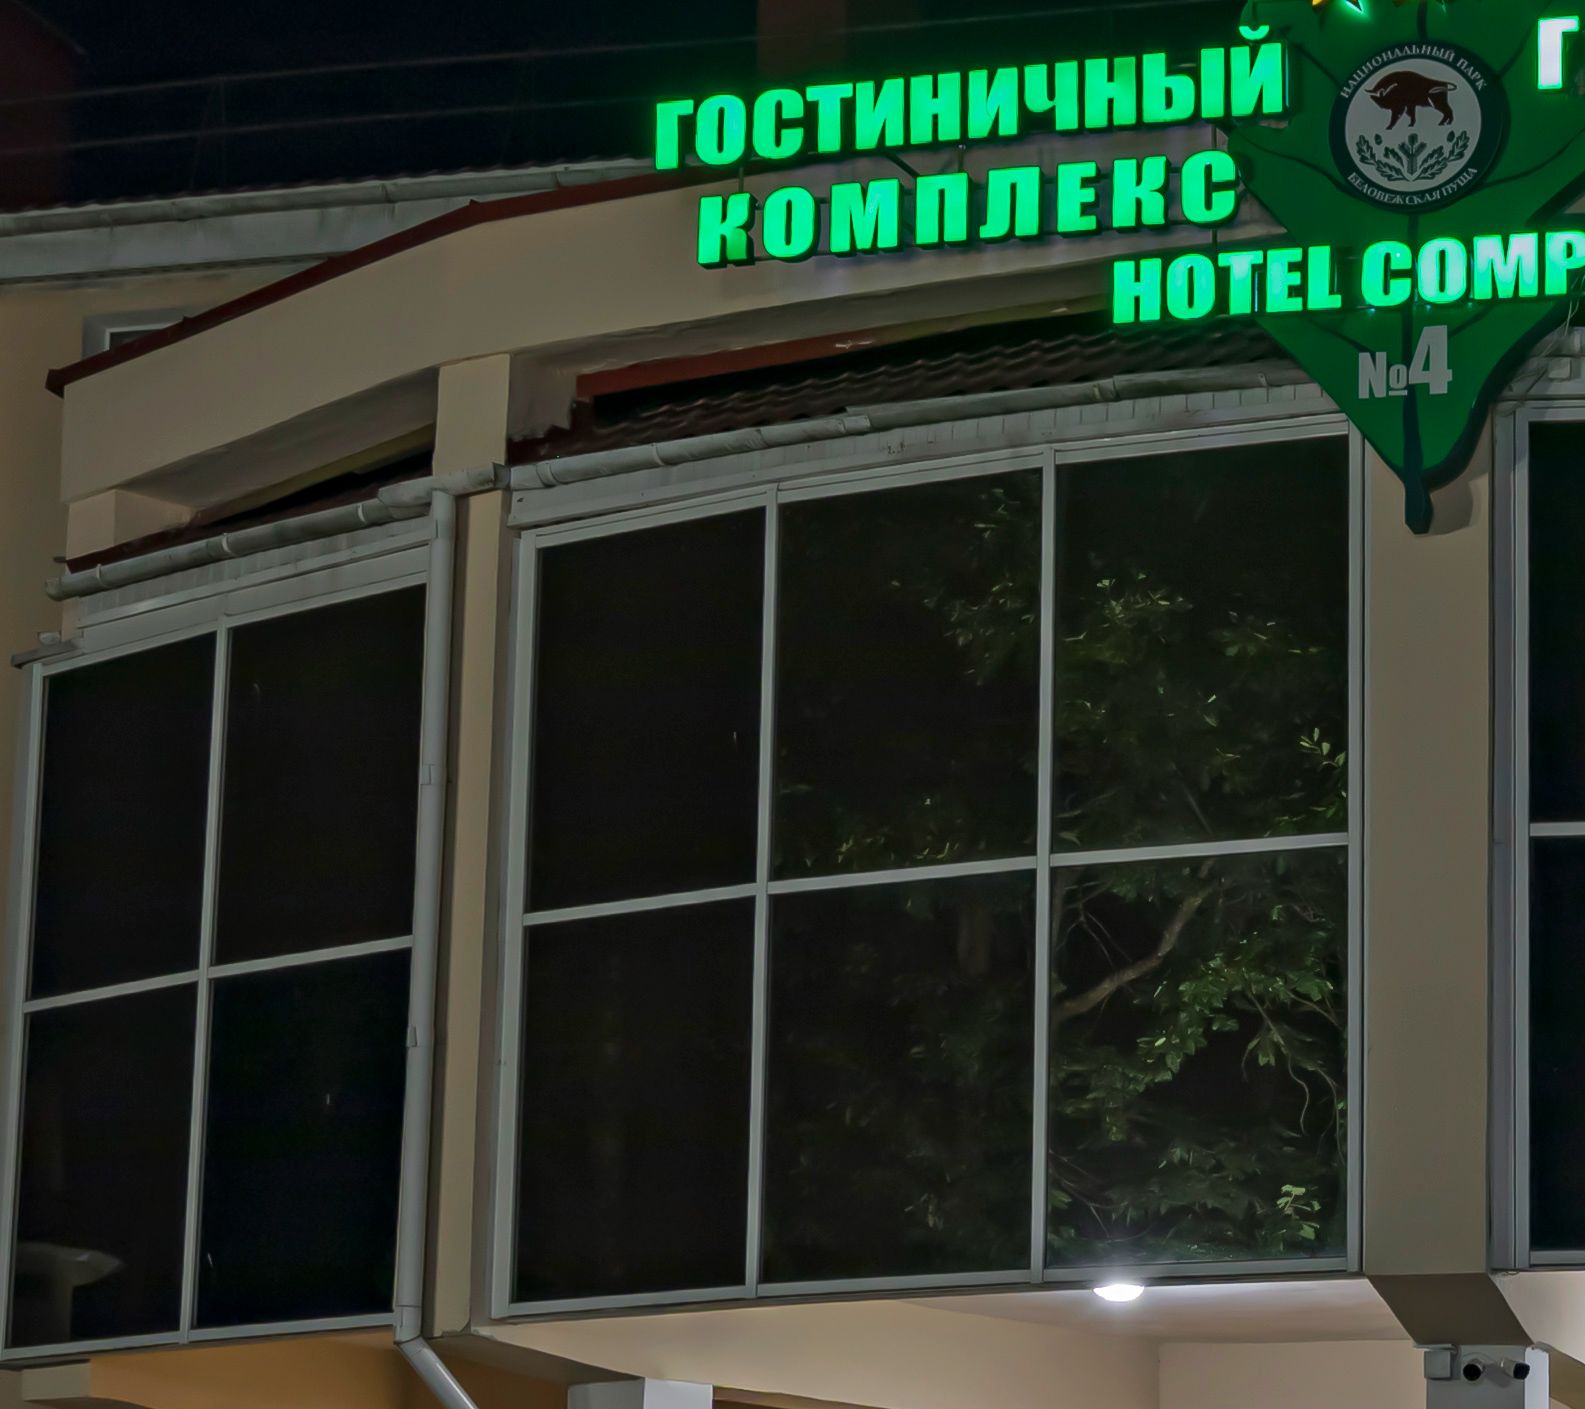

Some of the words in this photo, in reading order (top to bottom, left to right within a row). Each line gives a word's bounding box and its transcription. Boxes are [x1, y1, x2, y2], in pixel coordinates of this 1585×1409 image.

[654, 24, 1287, 172] ГОСТИНИЧНЫЙ
[1340, 43, 1455, 99] НАЦИОНАЛЬНЫЙ
[1456, 57, 1489, 92] ПАРК
[696, 148, 1240, 267] КОМПЛЕКС
[1347, 171, 1441, 206] БЕЛОВЕЖСКАЯ
[1442, 166, 1479, 197] ПУЩА
[1111, 244, 1344, 325] HOTEL
